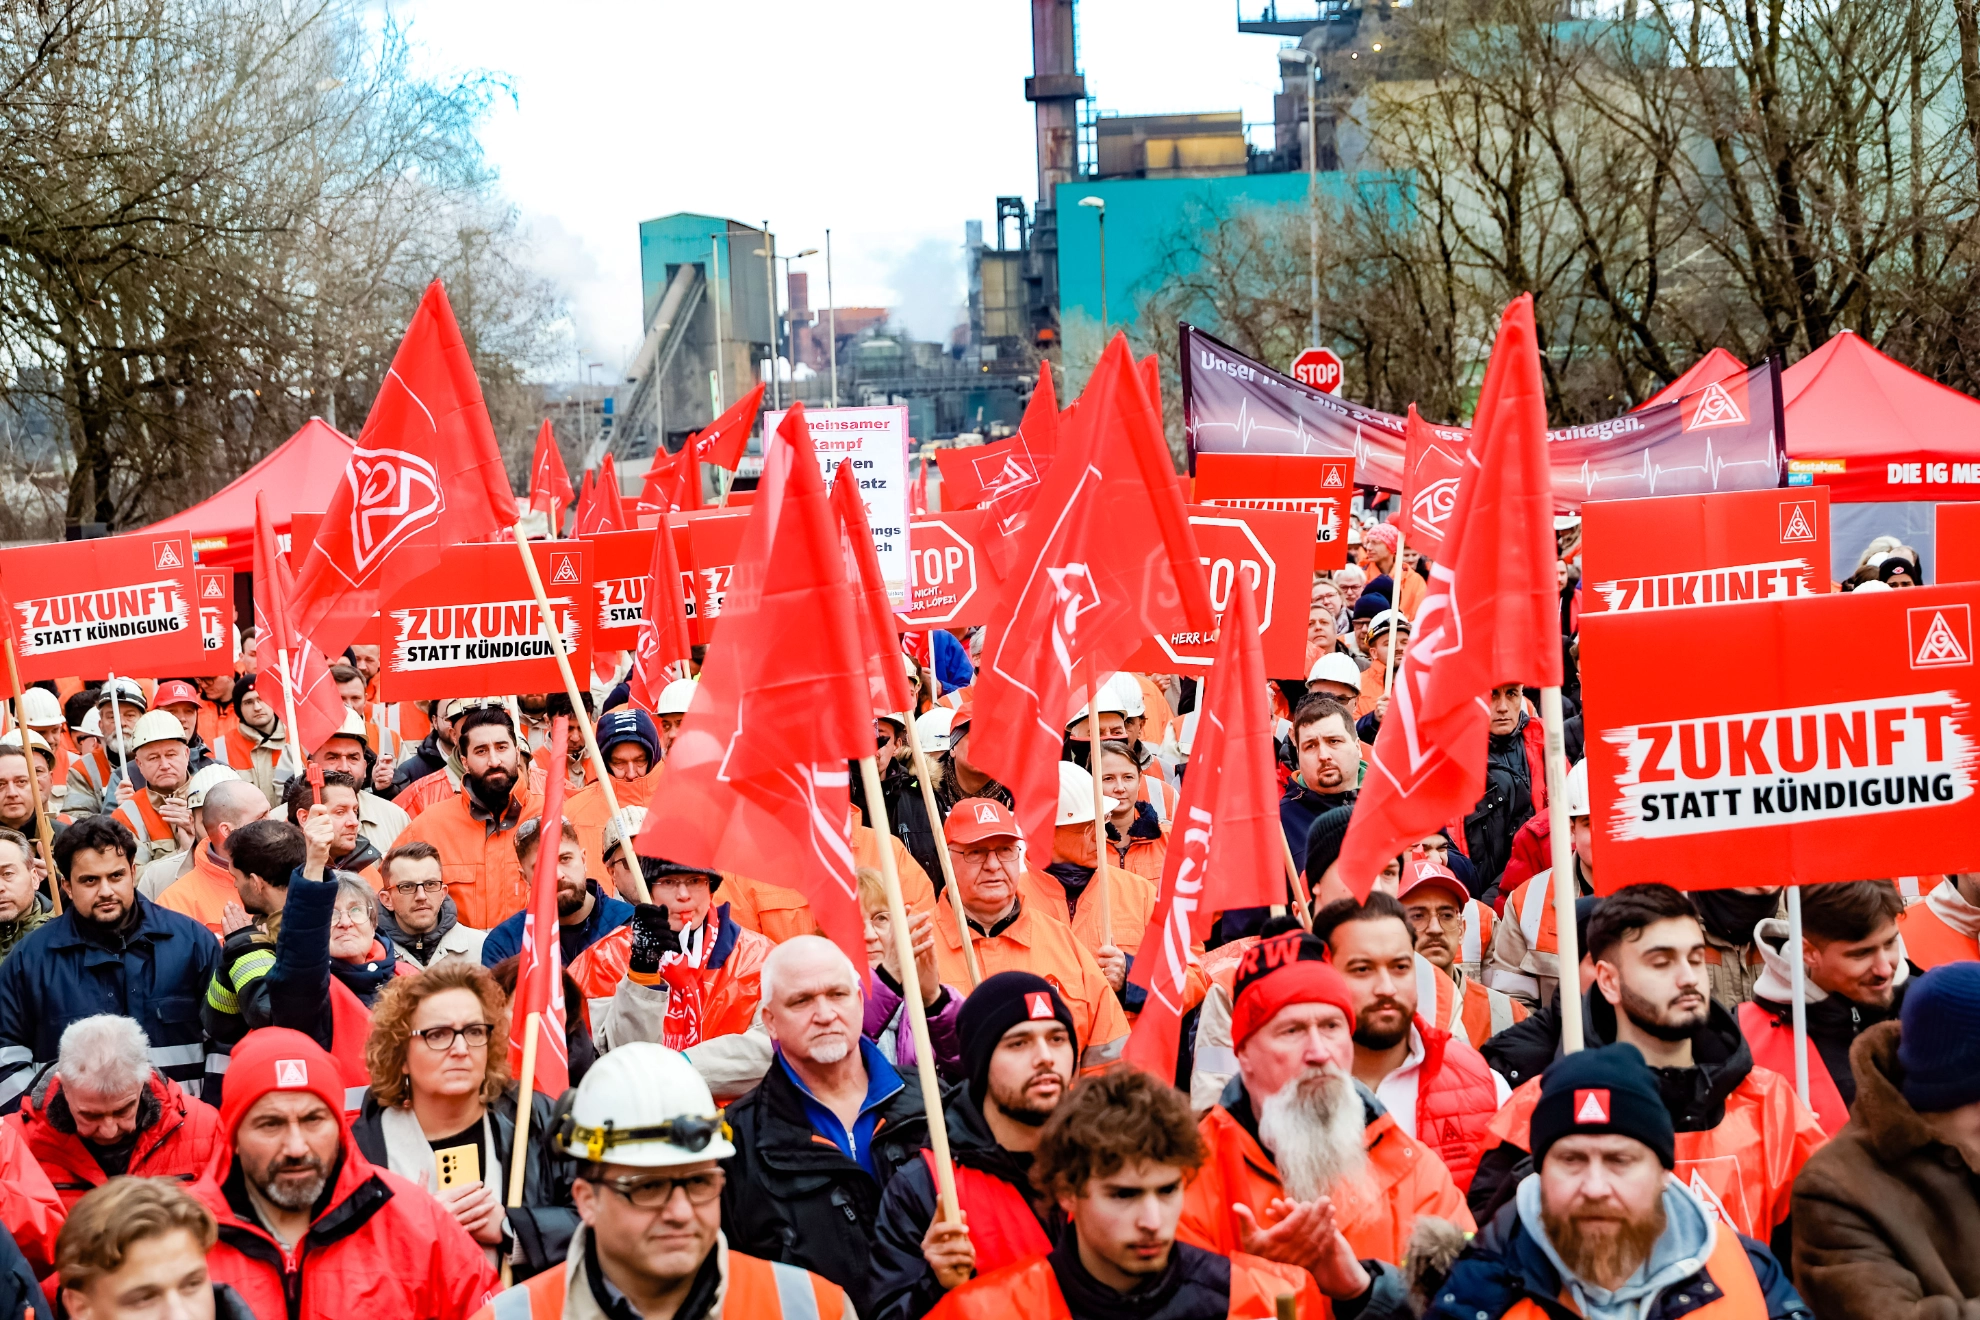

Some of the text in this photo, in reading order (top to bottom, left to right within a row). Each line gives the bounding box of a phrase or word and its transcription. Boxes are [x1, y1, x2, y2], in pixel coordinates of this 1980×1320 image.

[1201, 350, 1258, 382] Unser
[1297, 362, 1338, 384] STOP
[1791, 461, 1844, 472] Gestalten.
[1887, 463, 1922, 484] DIE
[1926, 463, 1949, 484] IG
[910, 546, 964, 587] TOP
[31, 585, 176, 628] ZUKUNFT
[610, 606, 644, 621] STAT
[911, 600, 926, 611] ERR
[35, 628, 82, 647] STATT
[87, 617, 179, 640] KÜNDIGUNG
[1171, 631, 1201, 645] HERR
[407, 644, 461, 662] STATT
[1638, 703, 1953, 783] ZUKUNFT
[1641, 773, 1954, 821] STATT KÜNDIGUNG
